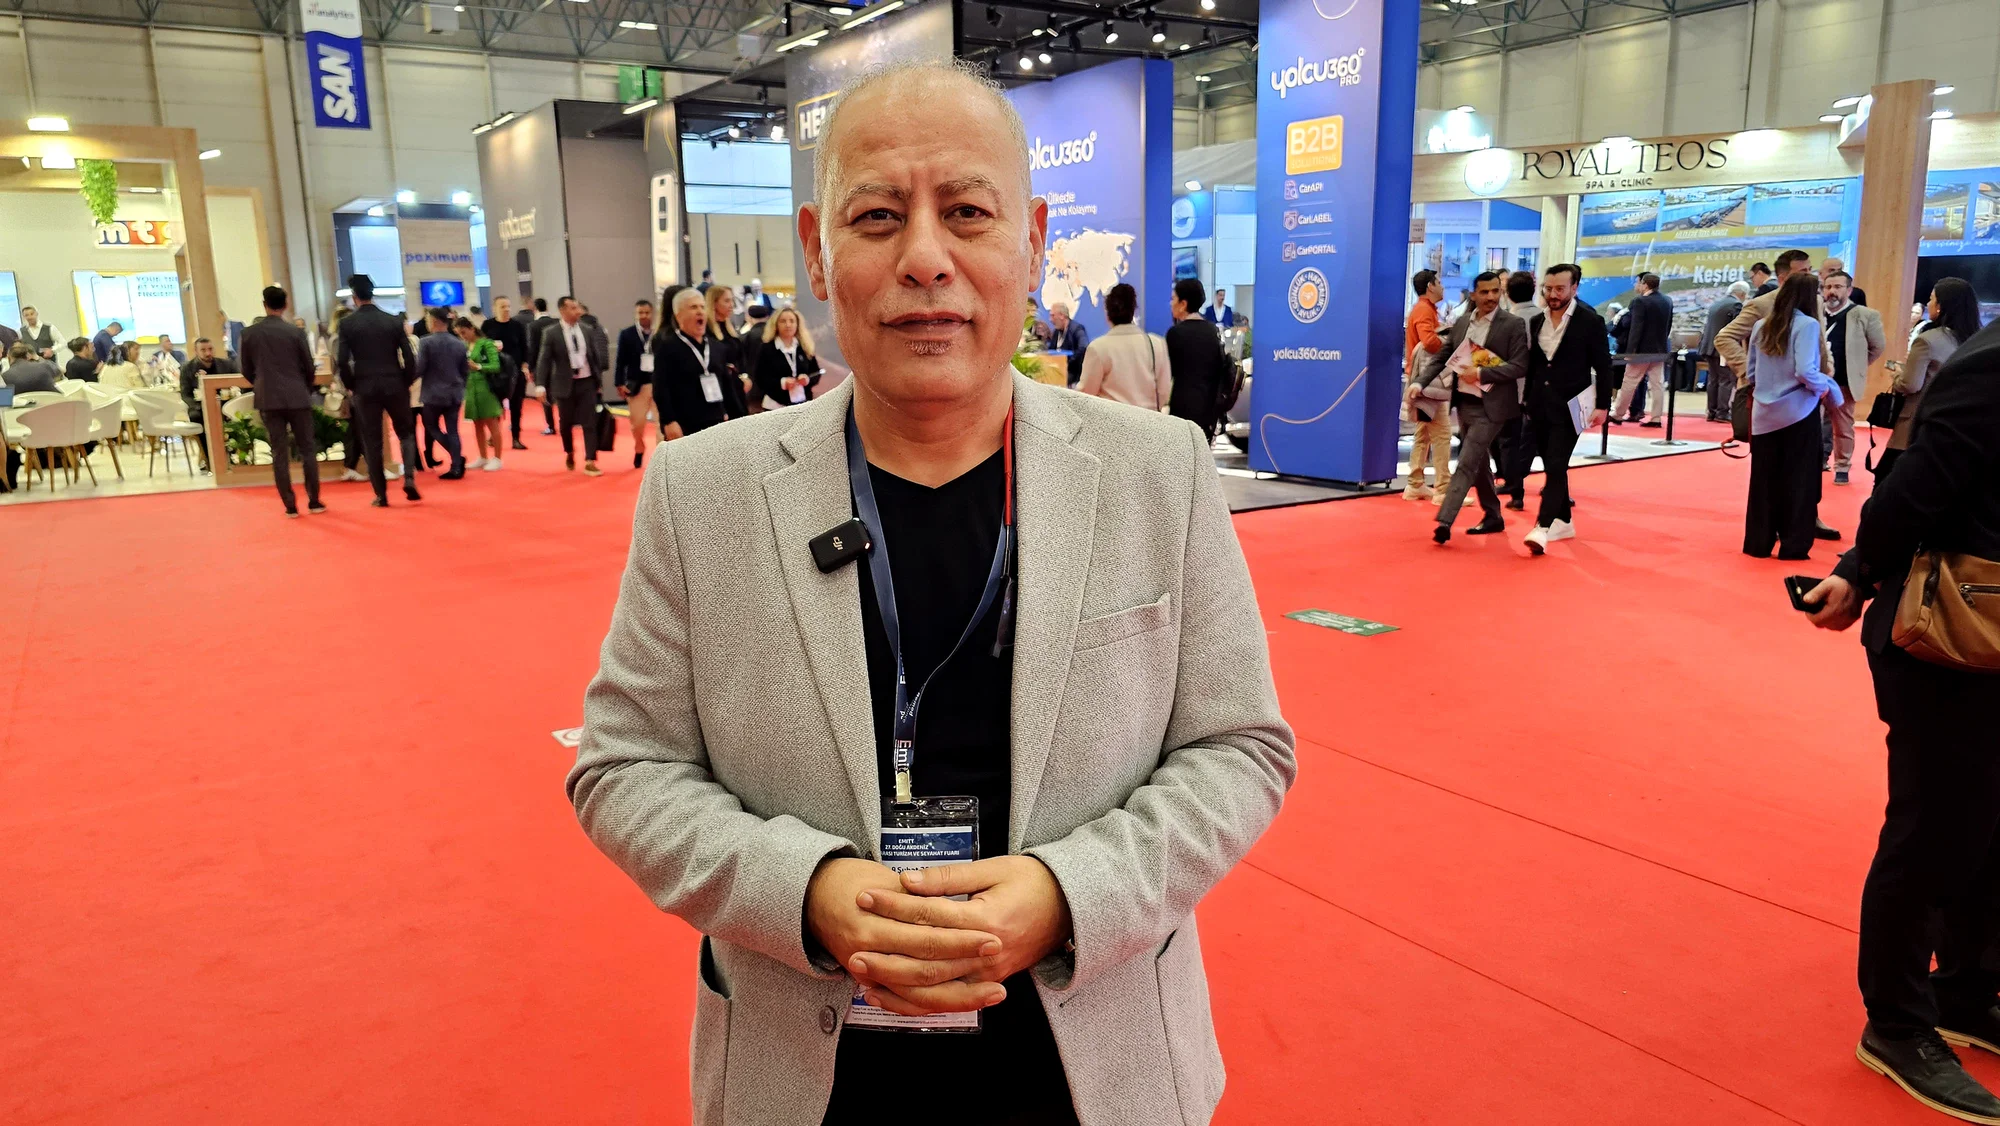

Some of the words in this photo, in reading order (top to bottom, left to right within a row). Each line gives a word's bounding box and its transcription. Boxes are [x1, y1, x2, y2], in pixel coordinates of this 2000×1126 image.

[317, 43, 356, 122] SAN
[1339, 74, 1361, 87] PRO
[1290, 123, 1338, 156] B2B
[1520, 147, 1622, 181] ROYAL
[1632, 139, 1729, 174] TEOS
[1585, 181, 1604, 190] SPA
[1610, 179, 1615, 188] &
[1621, 177, 1654, 187] CLINIC
[1298, 213, 1333, 225] CarLABEL
[1296, 244, 1337, 256] CarPORTAL
[405, 252, 472, 266] paximum
[1692, 263, 1745, 287] Keşfet
[1273, 347, 1342, 361] yolcu360.com
